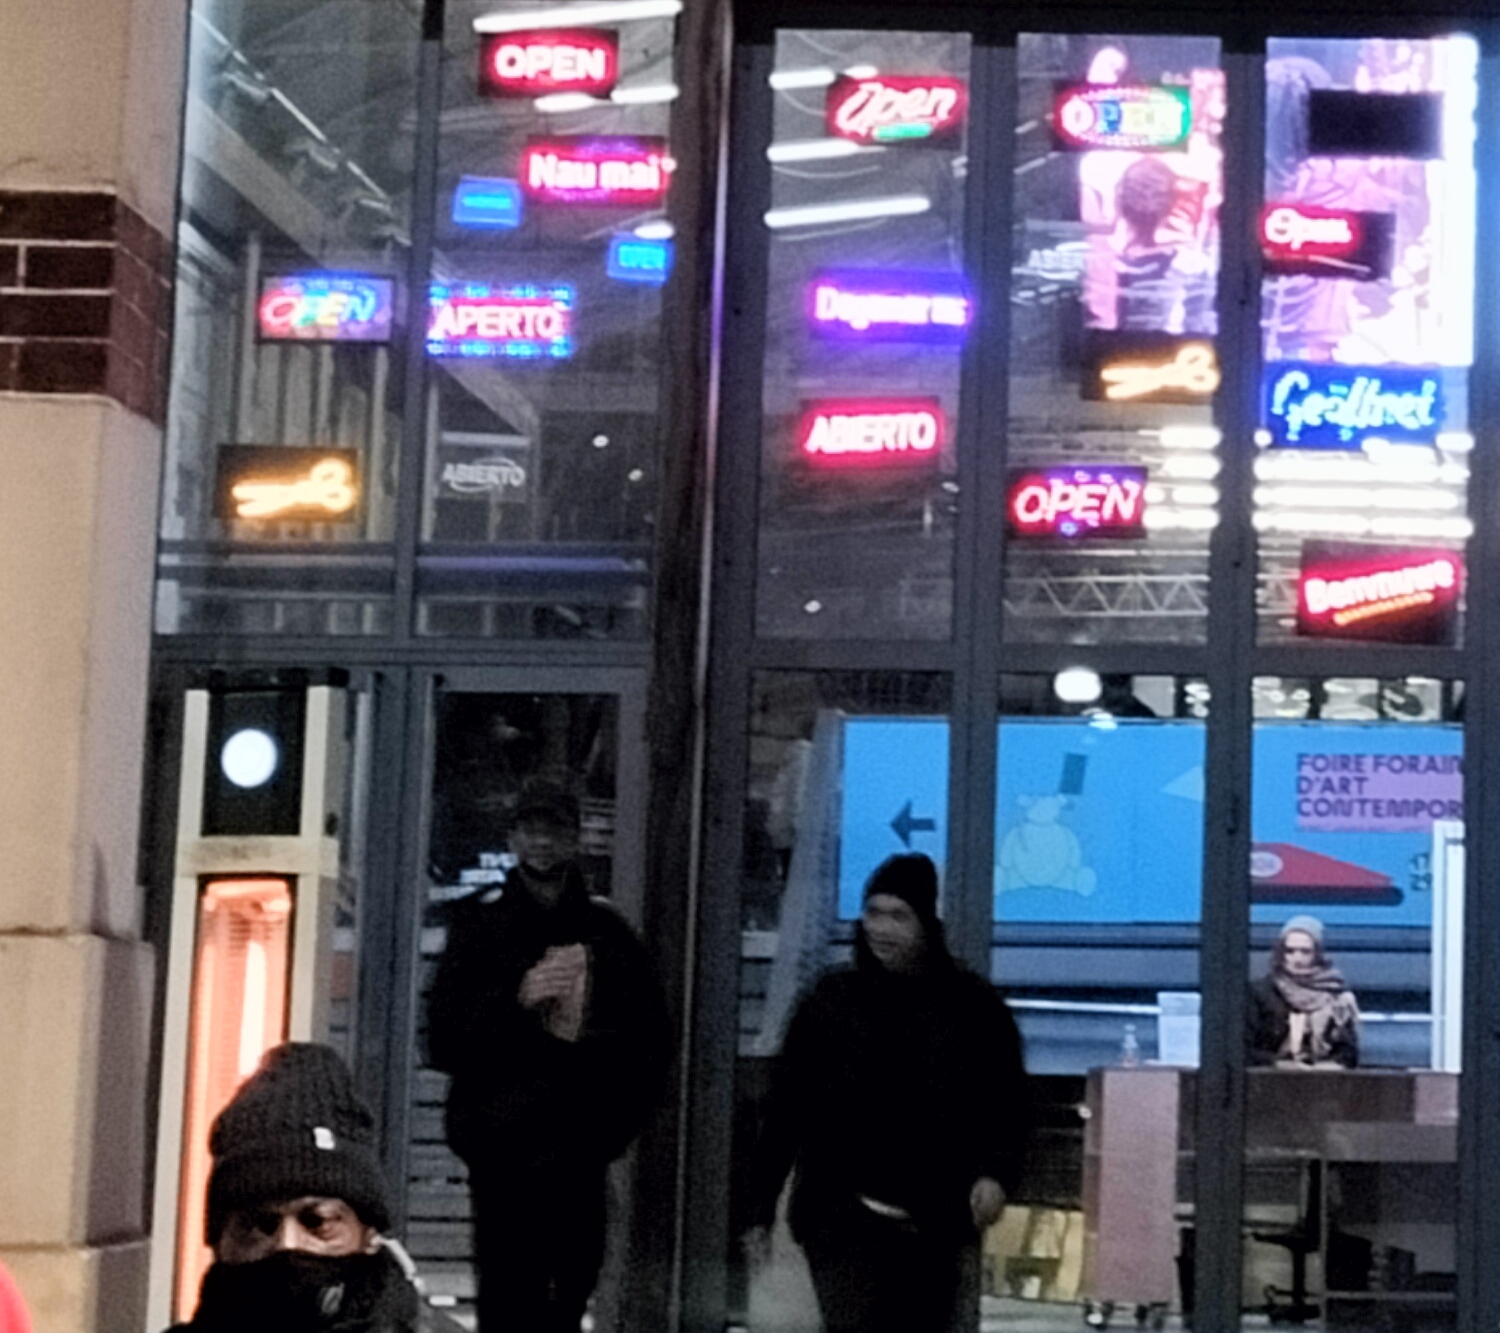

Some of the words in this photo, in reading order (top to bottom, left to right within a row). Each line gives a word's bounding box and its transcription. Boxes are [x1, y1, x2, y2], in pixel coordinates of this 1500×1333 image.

[495, 46, 607, 80] OPEN
[835, 82, 958, 138] Open
[262, 293, 375, 329] OPEN
[429, 303, 563, 339] APERTO
[804, 412, 938, 454] ABIERTO
[1013, 481, 1141, 523] OPEN
[1297, 754, 1365, 773] FOIRE
[1297, 777, 1369, 795] D'ART
